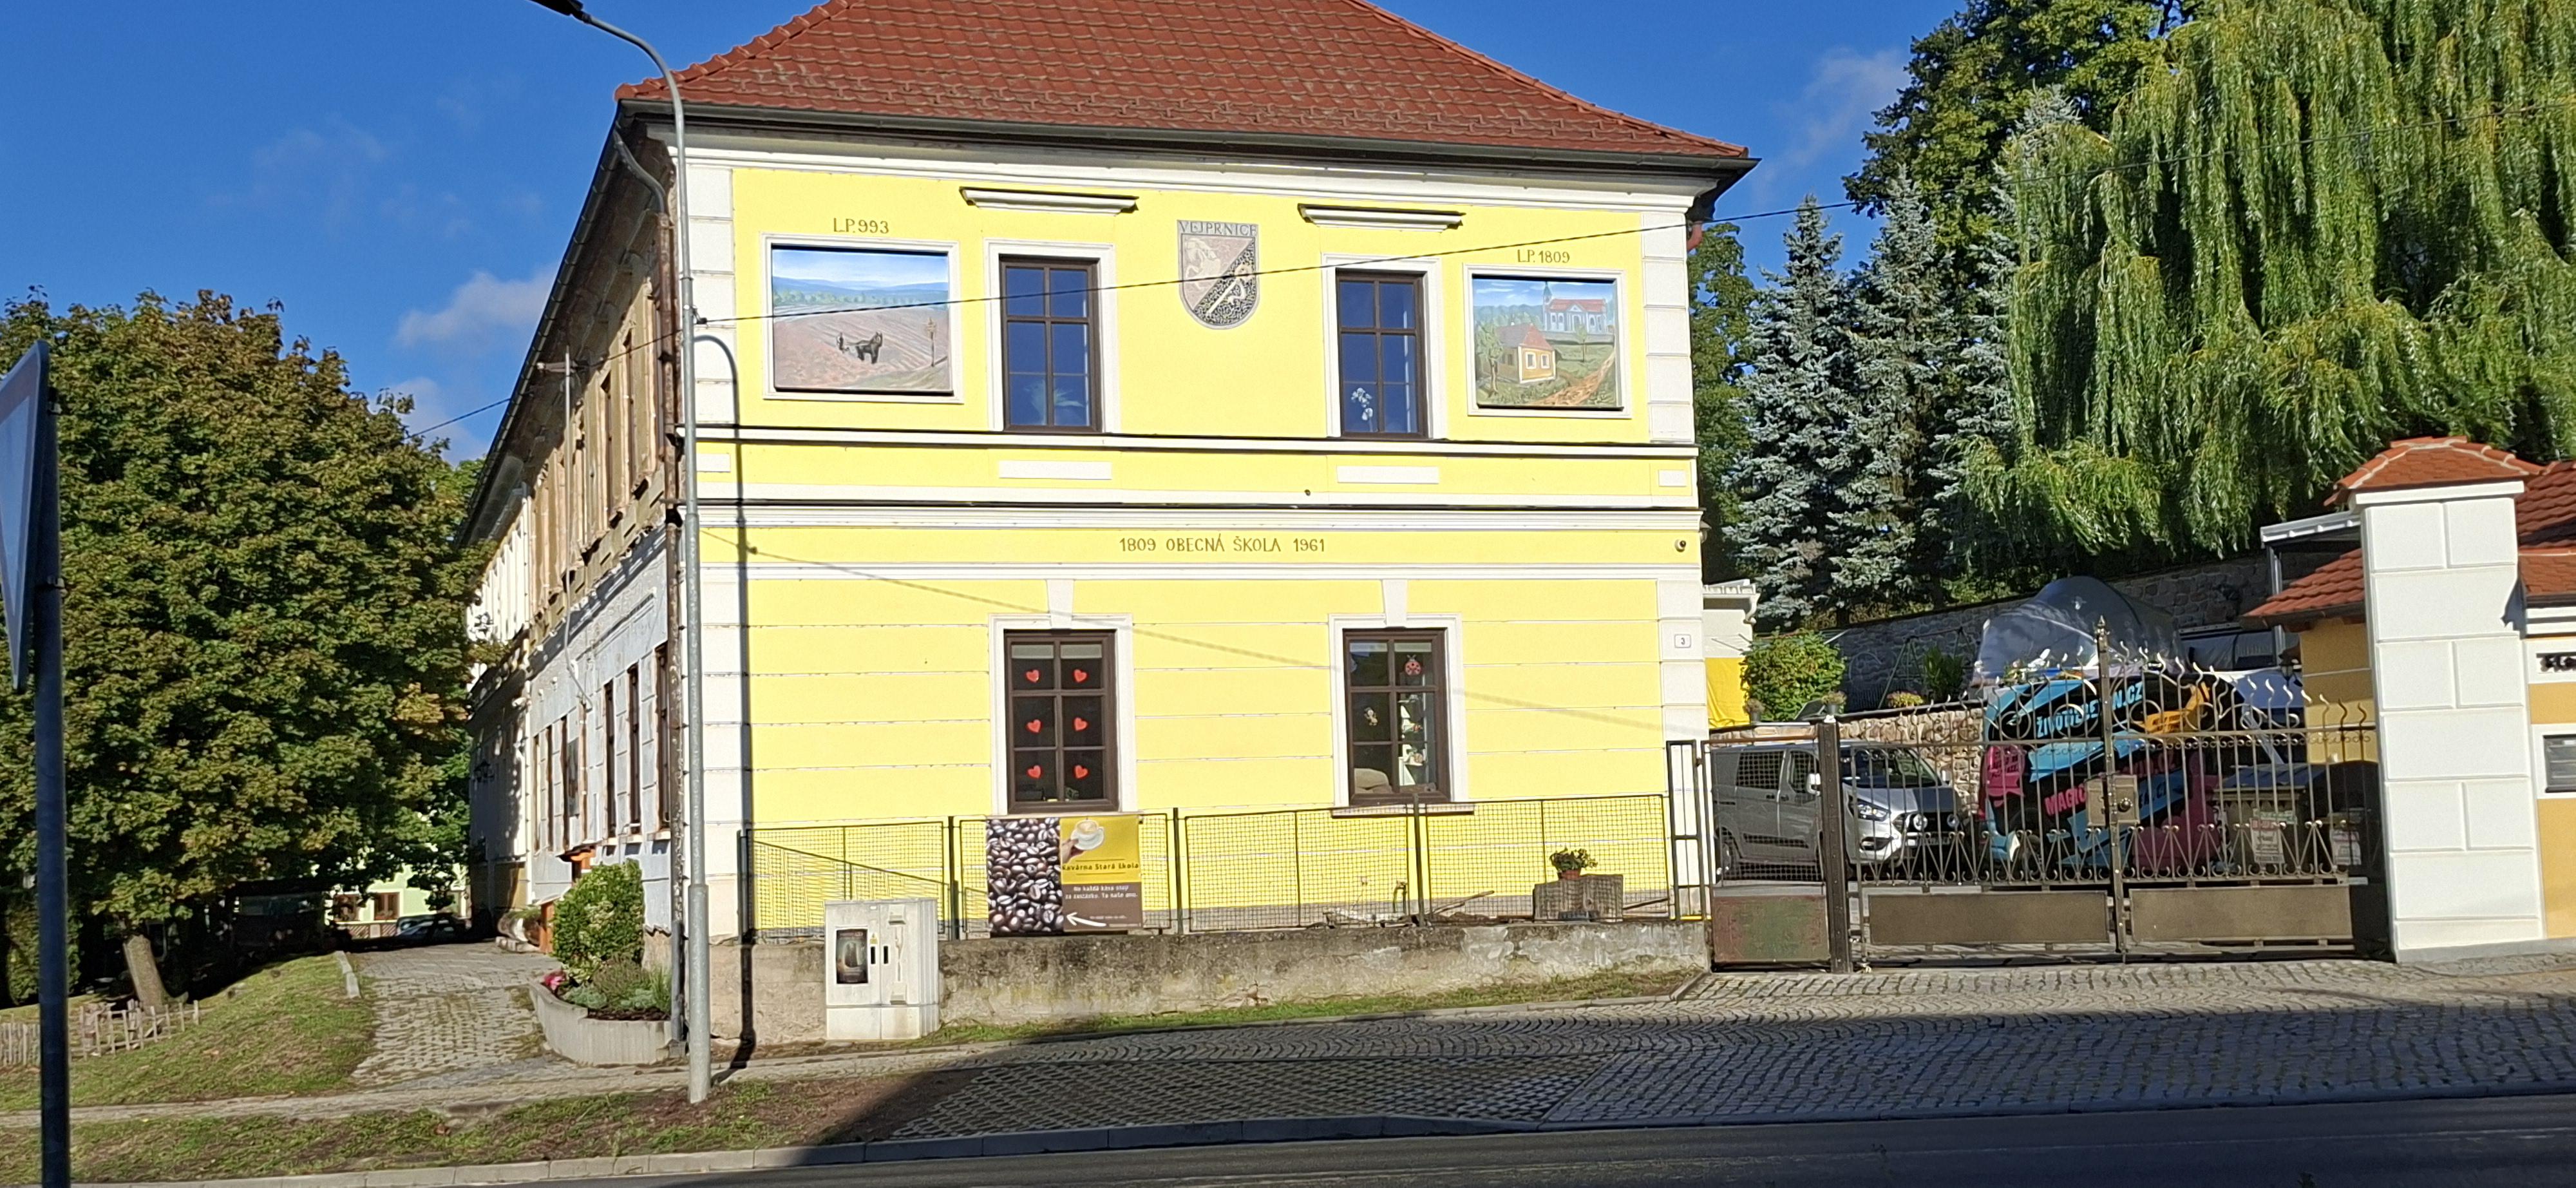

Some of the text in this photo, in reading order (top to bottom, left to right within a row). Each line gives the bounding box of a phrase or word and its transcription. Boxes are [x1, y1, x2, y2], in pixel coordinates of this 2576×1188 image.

[1179, 221, 1256, 236] VEJPRNICE
[1119, 533, 1325, 552] 1809 OBECNÁ ŠKOLA 1961
[1680, 637, 1686, 646] 3
